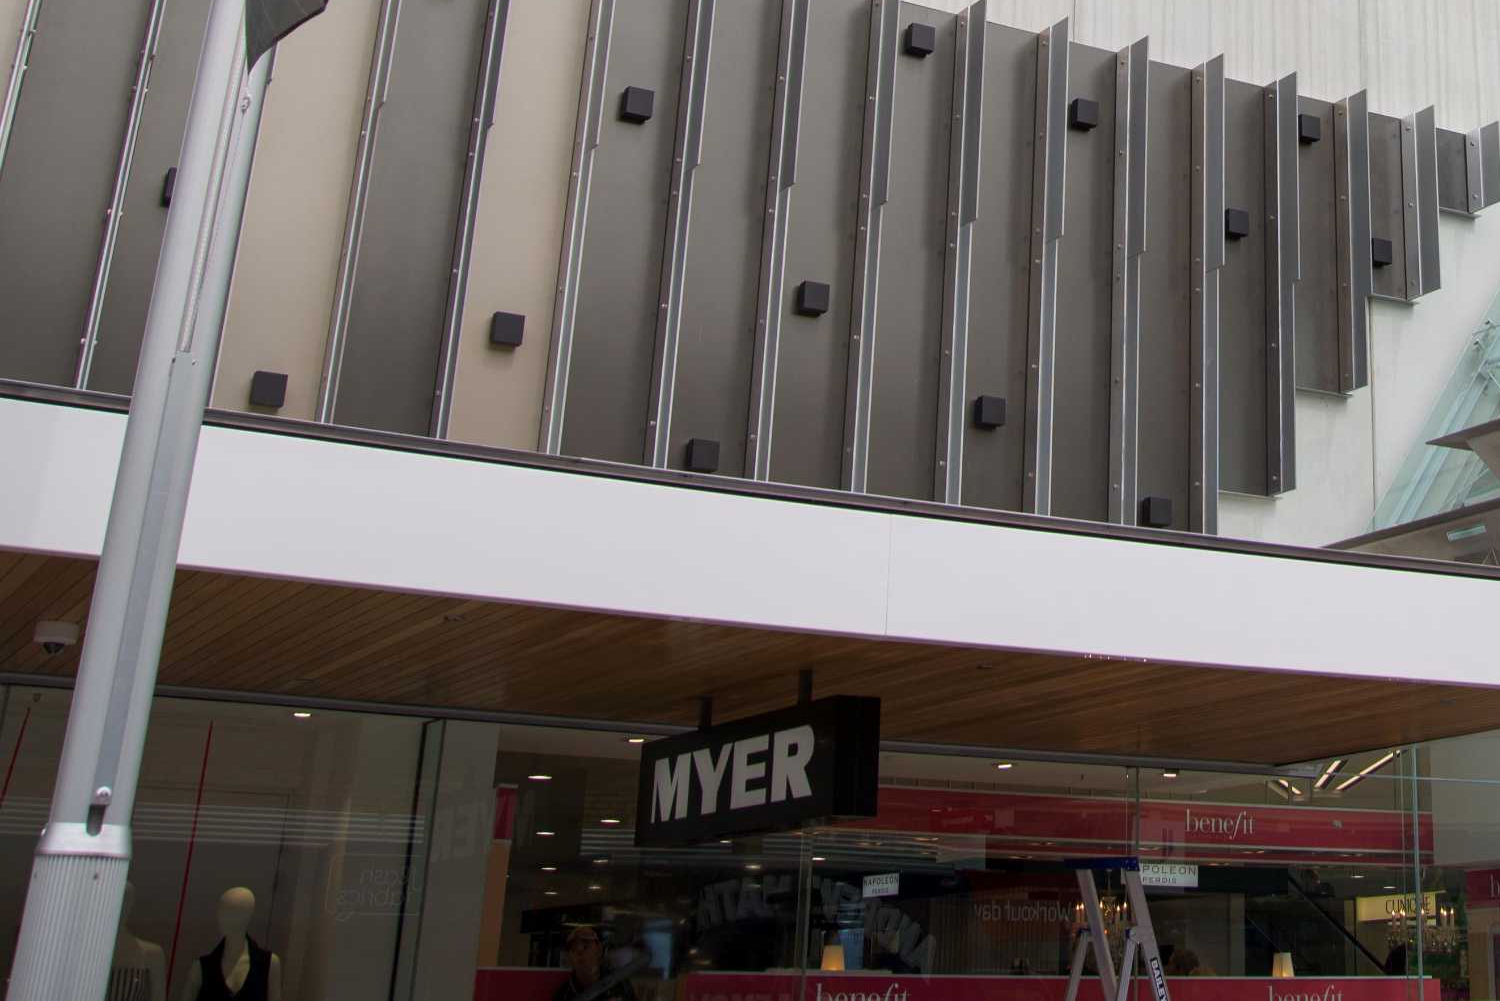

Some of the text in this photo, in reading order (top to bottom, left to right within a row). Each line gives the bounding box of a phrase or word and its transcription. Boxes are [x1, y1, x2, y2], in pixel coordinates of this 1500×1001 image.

[650, 725, 815, 824] MYER
[1185, 809, 1255, 840] benefit
[1142, 865, 1196, 875] POLEON
